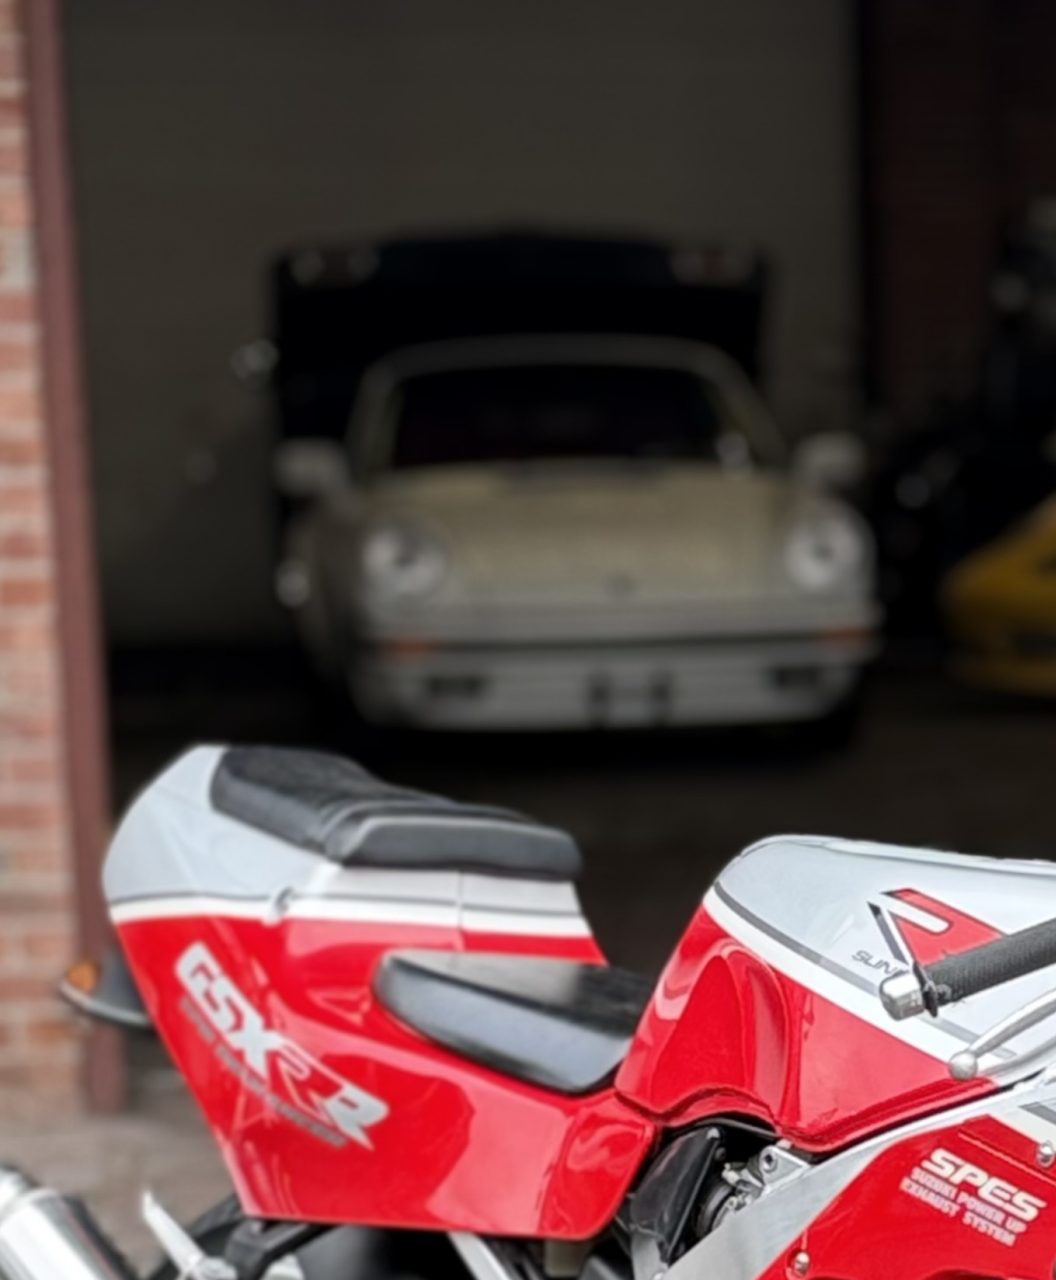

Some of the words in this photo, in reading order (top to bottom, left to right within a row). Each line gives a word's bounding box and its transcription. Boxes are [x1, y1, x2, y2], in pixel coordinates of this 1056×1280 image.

[921, 1147, 1048, 1222] SPES
[956, 1191, 1006, 1225] POWER
[1005, 1215, 1028, 1234] UP
